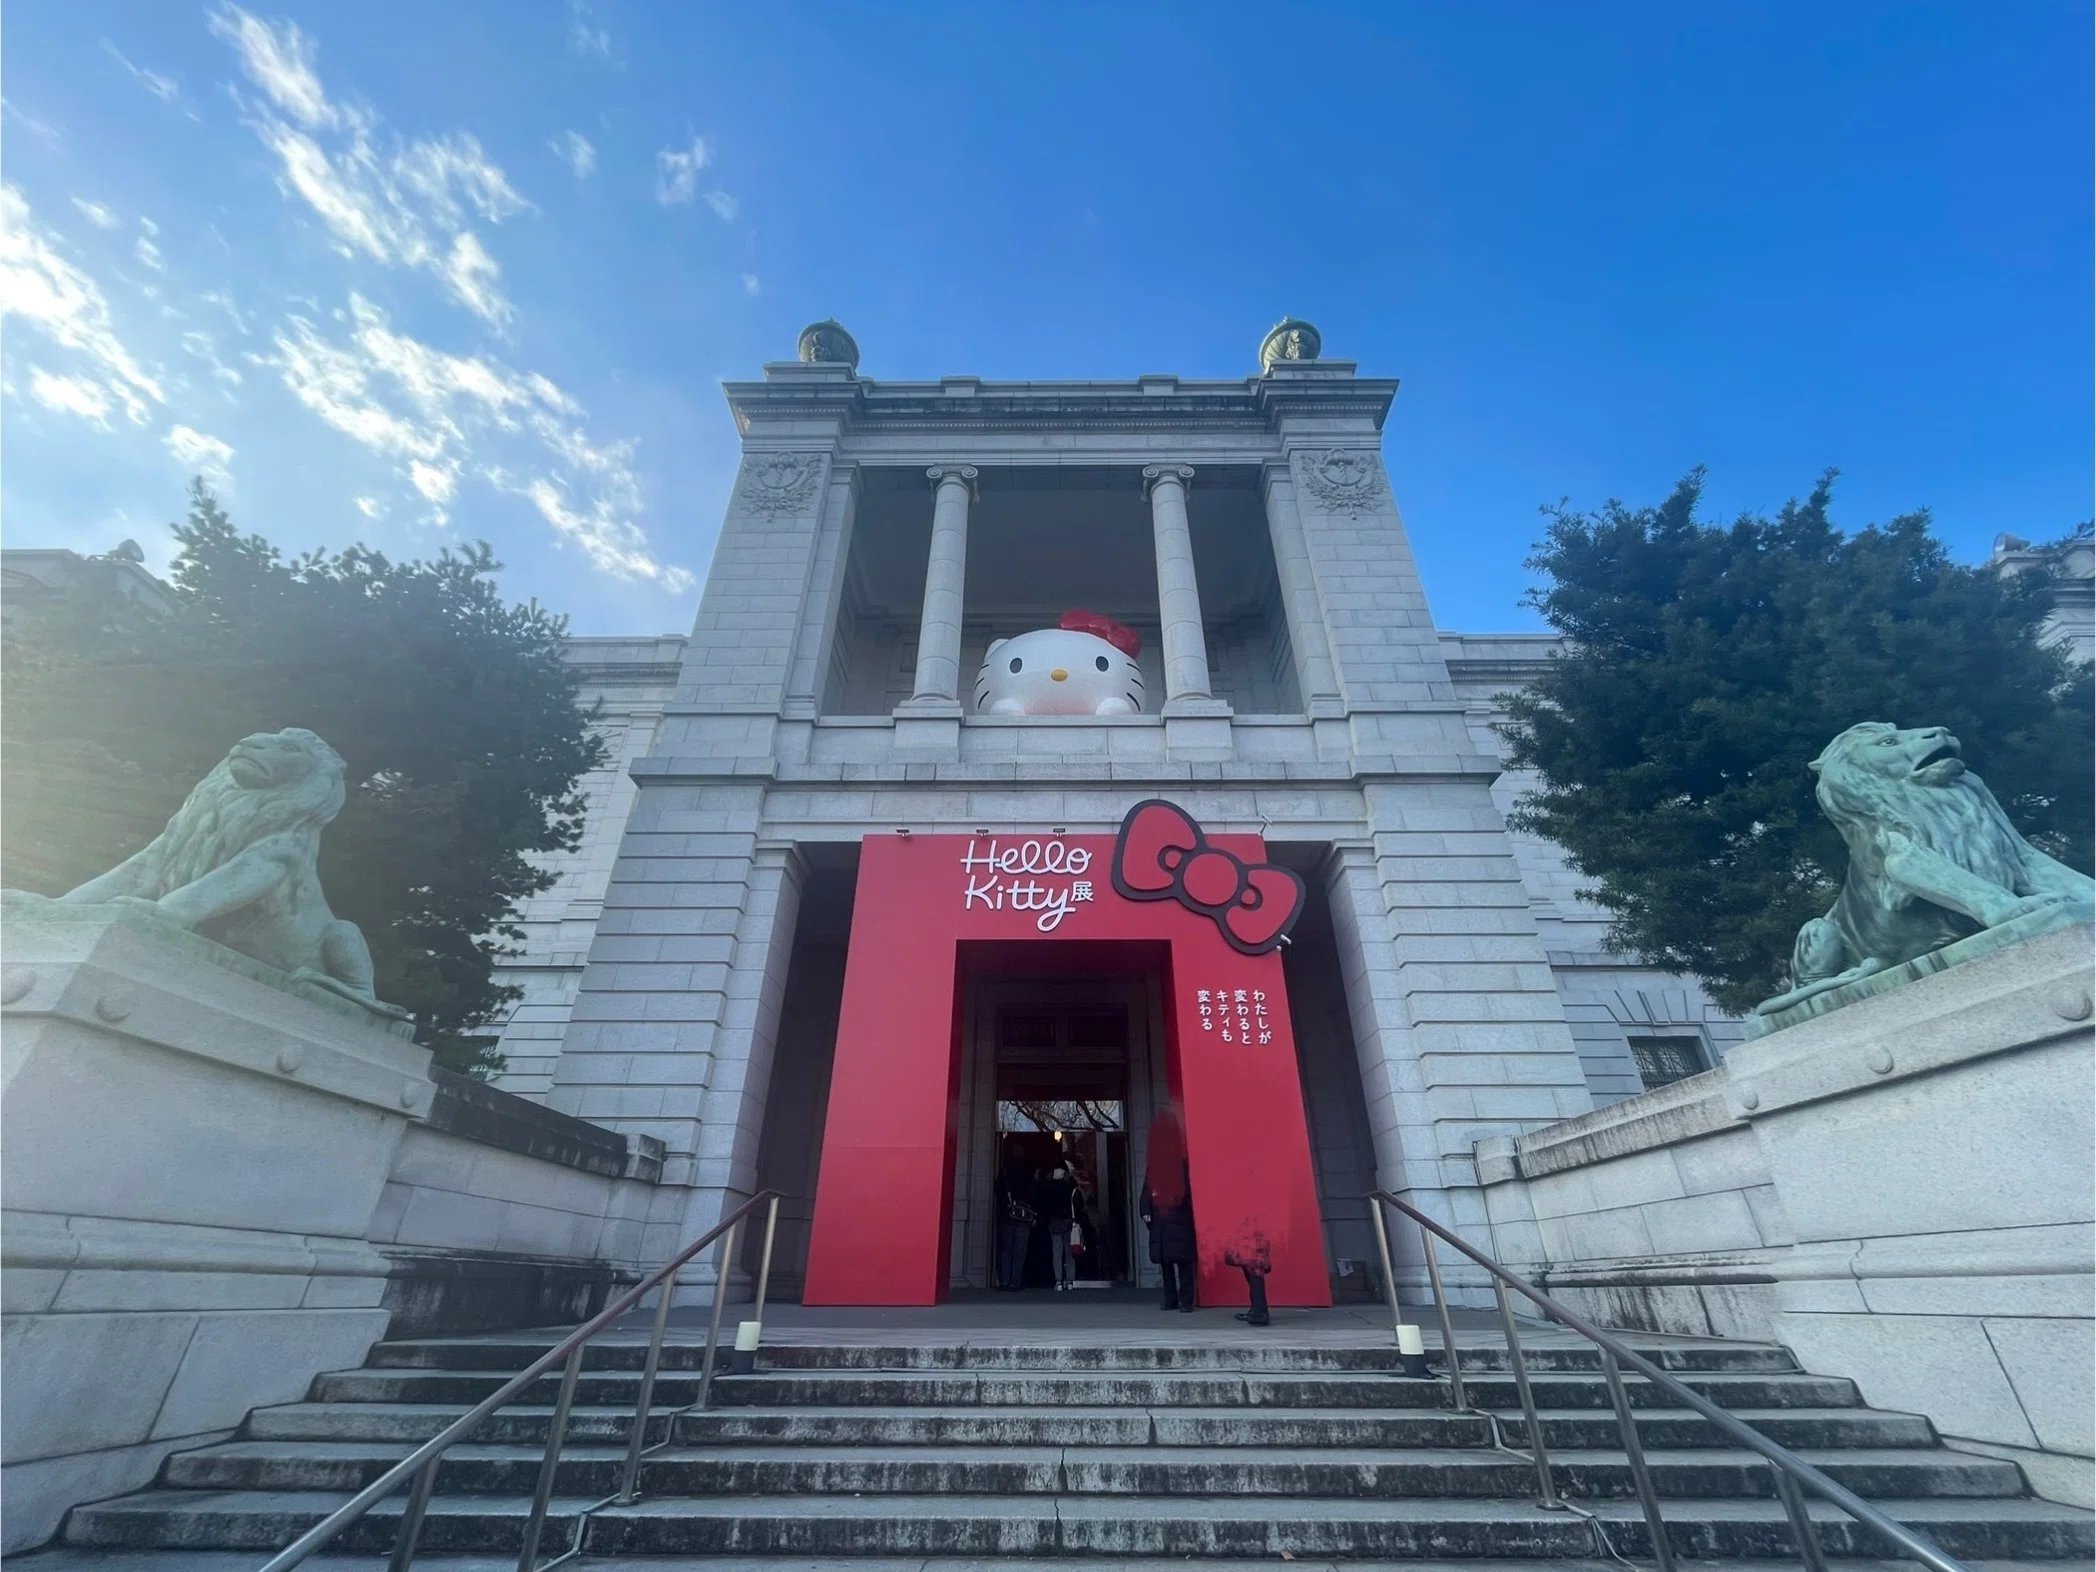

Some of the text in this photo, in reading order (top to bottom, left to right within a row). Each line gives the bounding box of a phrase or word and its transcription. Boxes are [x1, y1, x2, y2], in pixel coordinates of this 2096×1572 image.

[960, 839, 1093, 875] Hello
[1197, 989, 1213, 1031] 変わる
[1216, 989, 1233, 1042] キティも
[1234, 989, 1252, 1045] 変わると
[1253, 989, 1272, 1045] わたしが
